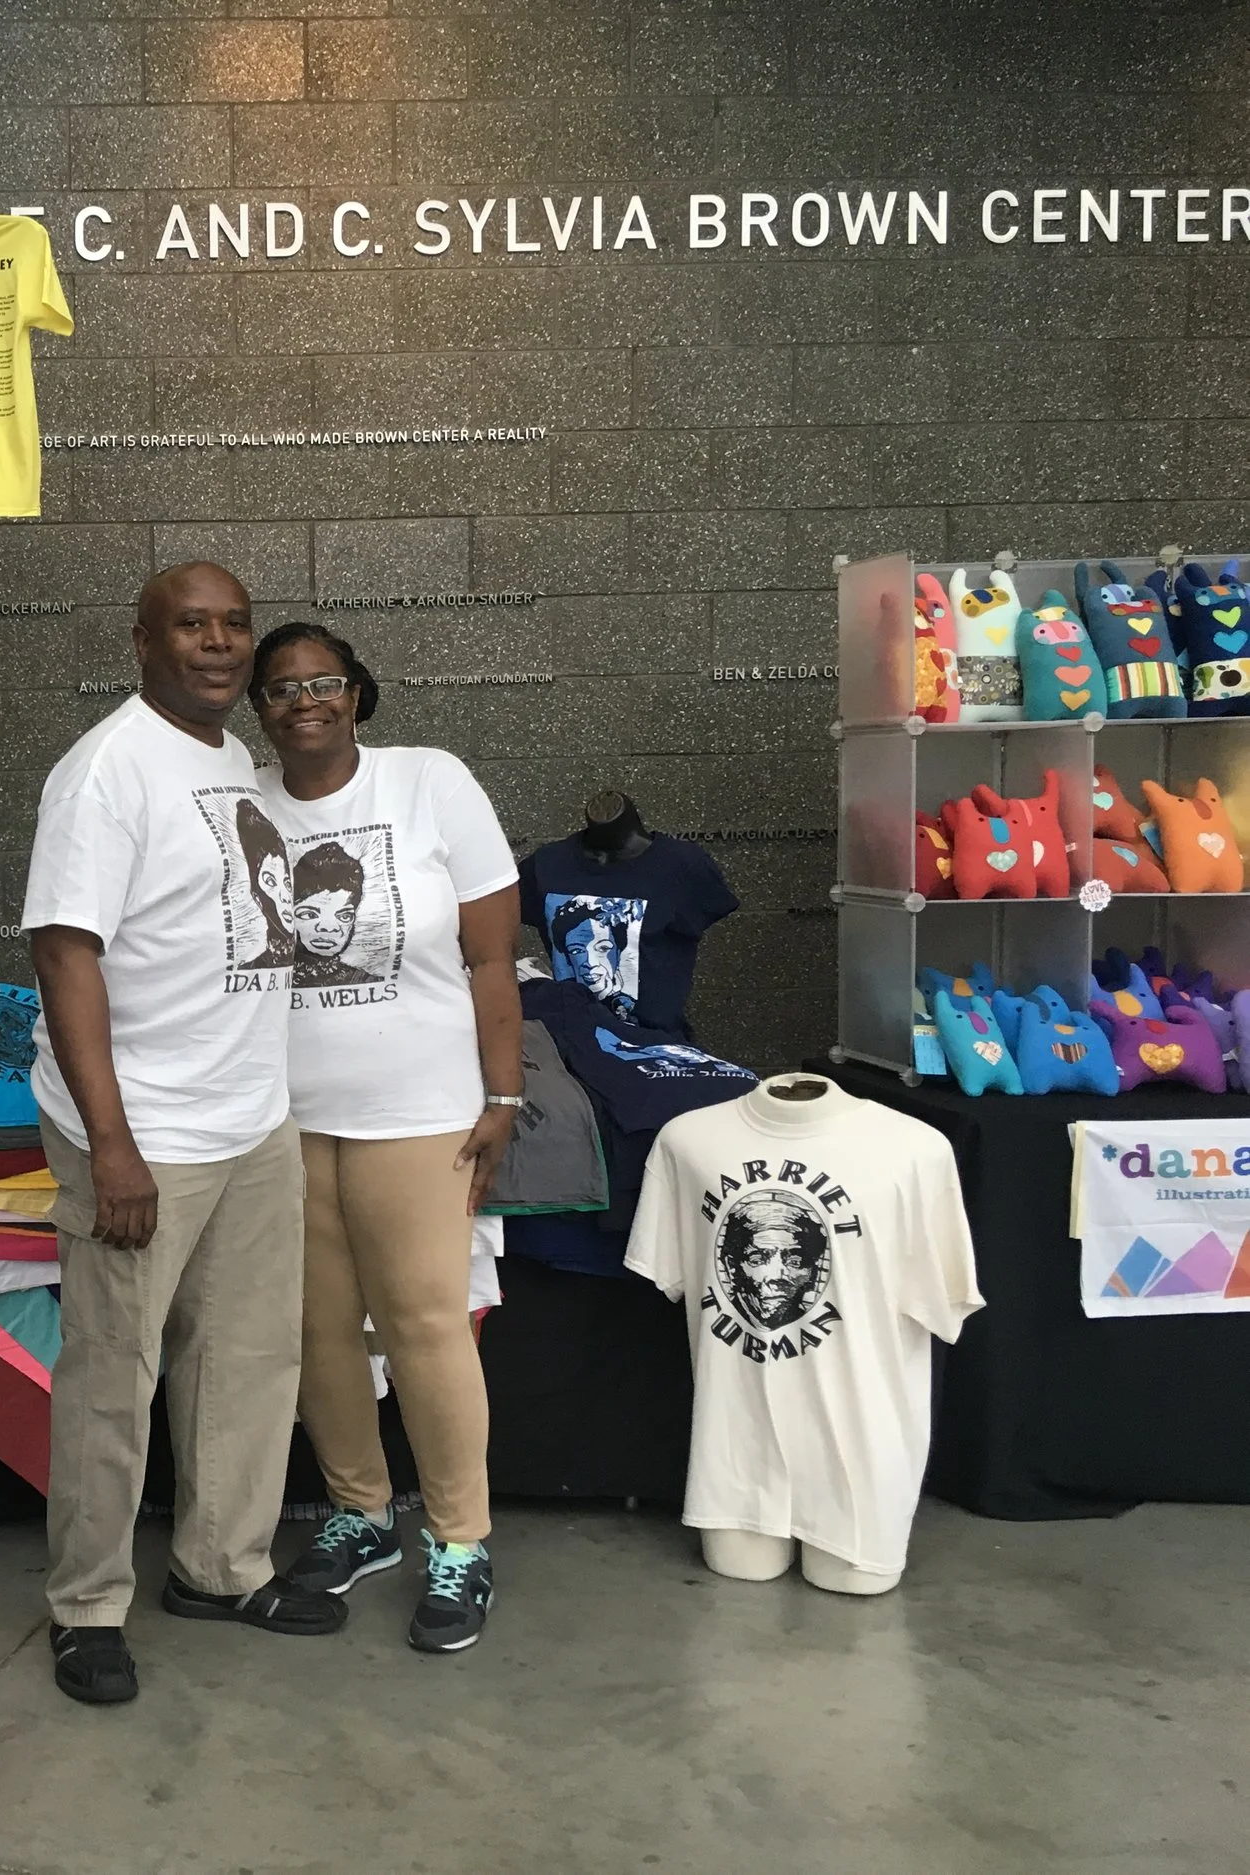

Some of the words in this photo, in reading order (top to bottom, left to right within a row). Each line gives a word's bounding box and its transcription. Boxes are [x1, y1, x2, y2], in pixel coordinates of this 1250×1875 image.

[75, 206, 124, 261] C.
[156, 202, 304, 260] AND
[333, 200, 384, 256] C.
[414, 195, 657, 256] SYLVIA
[688, 190, 948, 249] BROWN
[981, 188, 1250, 244] CENTER
[67, 436, 85, 449] OF
[90, 435, 117, 448] ART
[123, 435, 136, 447] IS
[140, 433, 214, 448] GRATEFUL
[219, 433, 237, 447] TO
[241, 432, 268, 447] ALL
[272, 432, 306, 446] WHO
[310, 430, 349, 445] MADE
[355, 429, 408, 444] BROWN
[412, 428, 469, 443] CENTER
[474, 427, 483, 441] A
[487, 427, 547, 441] REALITY
[316, 596, 396, 610] KATHERINE
[402, 596, 413, 608] &
[417, 594, 475, 607] ARNOLD
[479, 592, 534, 606] SNIDER
[404, 676, 423, 687] THE
[427, 674, 481, 687] SHERIDAN
[485, 672, 554, 686] FOUNDATION
[713, 667, 745, 681] BEN
[751, 667, 763, 681] &
[768, 664, 819, 680] ZELDA
[198, 786, 211, 796] MAN
[212, 785, 225, 795] WAS
[301, 830, 340, 844] LYNCHED
[341, 823, 393, 836] YESTERDAY
[704, 829, 715, 841] &
[720, 828, 789, 841] VIRGINIA
[223, 909, 234, 933] WAS
[226, 936, 235, 962] MAN
[224, 974, 262, 993] IDA
[318, 983, 399, 1009] WELLS
[701, 1159, 863, 1238] HARRIET
[701, 1286, 843, 1364] TUBMAN
